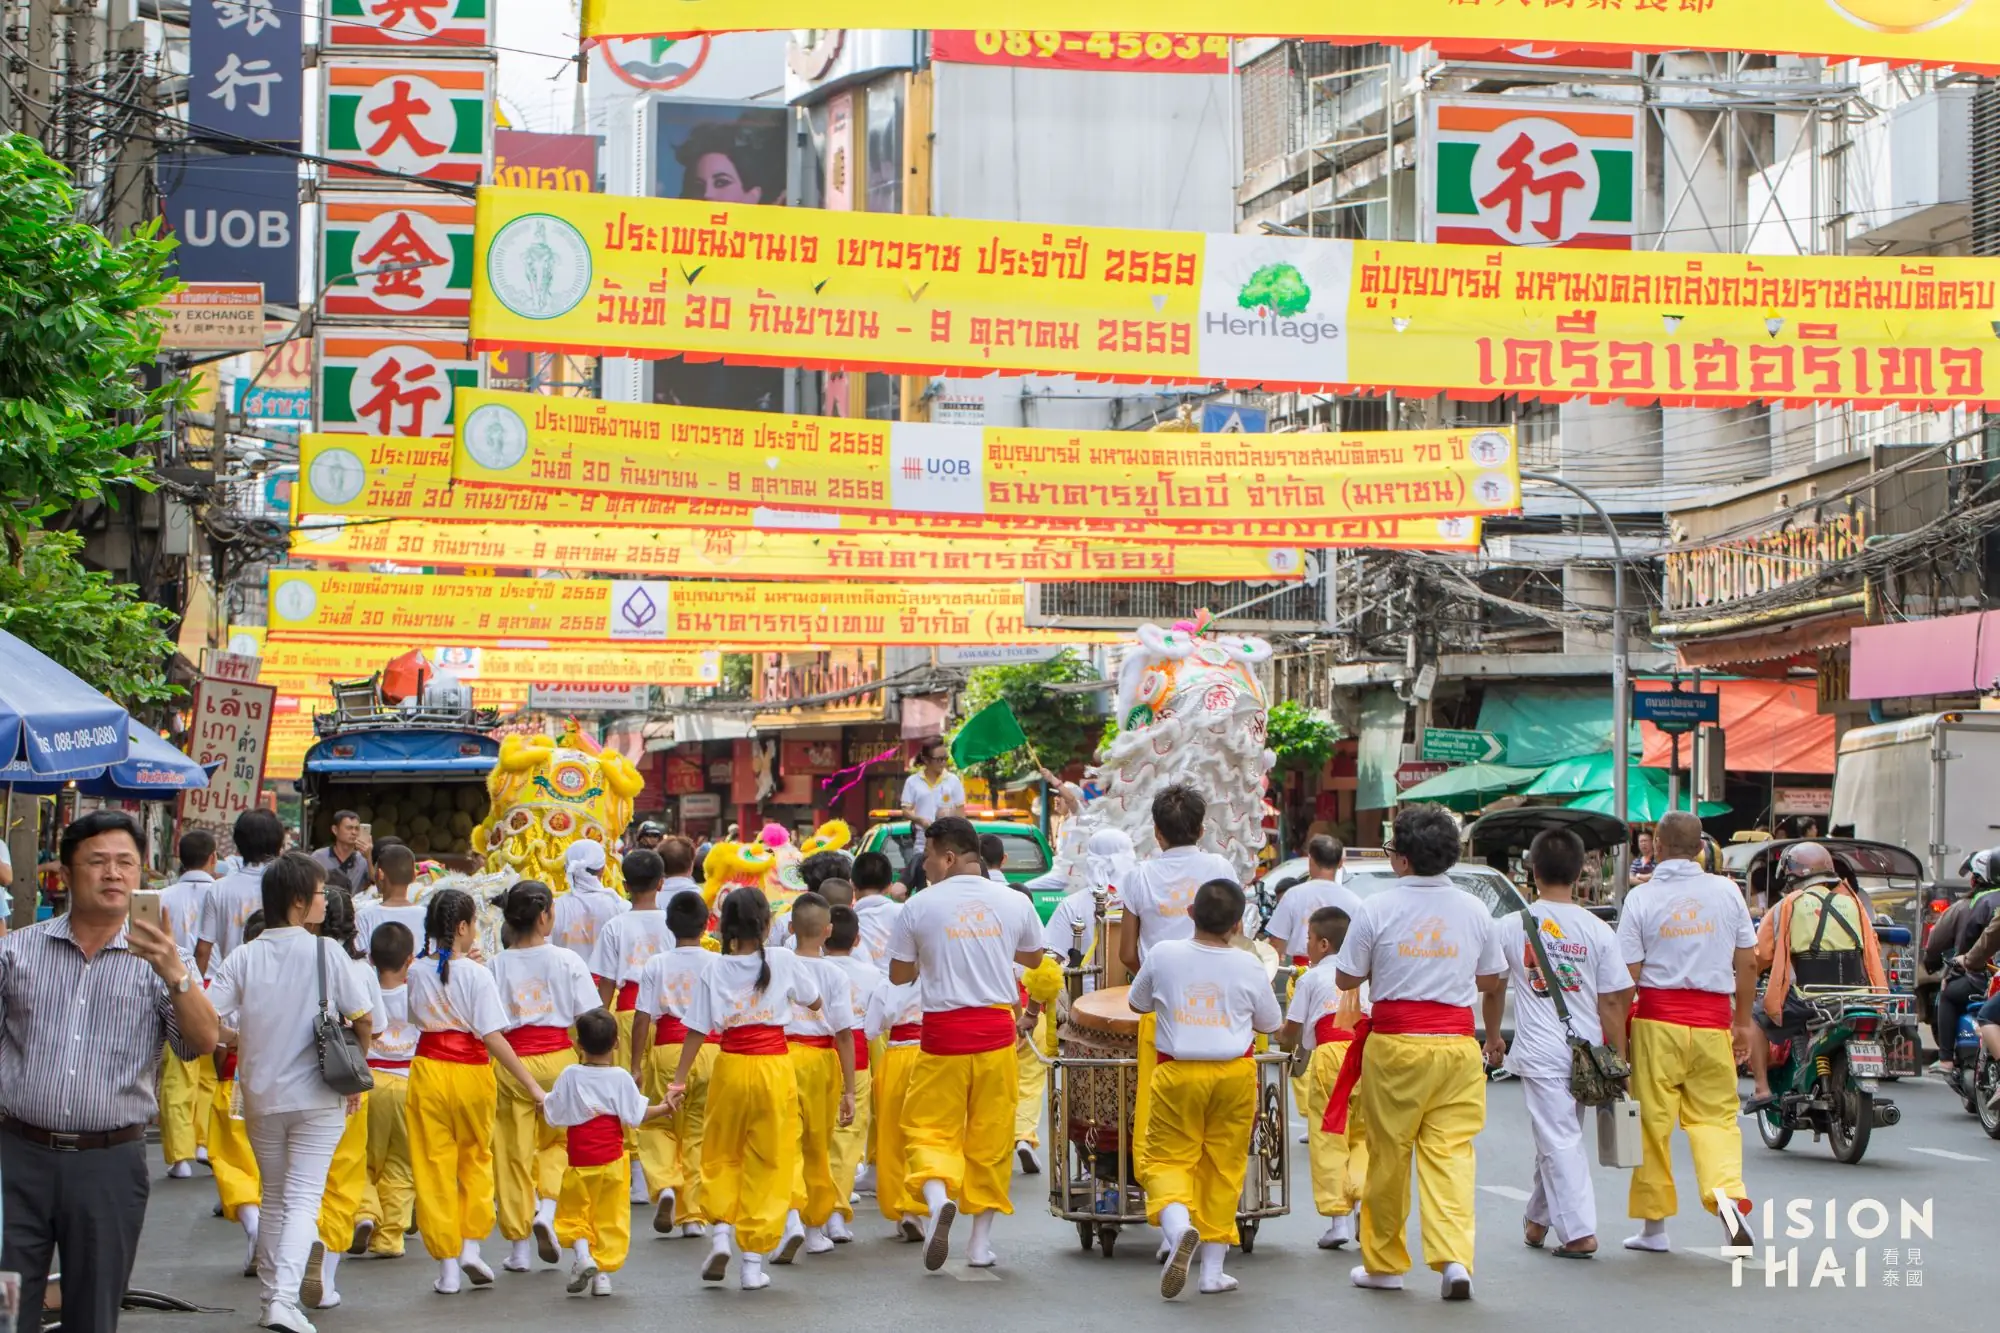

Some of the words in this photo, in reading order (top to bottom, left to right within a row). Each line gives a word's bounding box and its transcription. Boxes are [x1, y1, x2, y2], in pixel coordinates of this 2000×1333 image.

[1480, 131, 1586, 241] 行
[184, 209, 291, 249] UOB
[604, 211, 818, 264] ประเพณีงานเจ
[837, 235, 961, 272] เยาวราช
[977, 233, 1089, 280] ประจำปี
[1104, 248, 1197, 286] 2559
[1360, 250, 1503, 309] คู่บุญบารมี
[187, 310, 255, 321] EXCHANGE
[597, 267, 668, 327] วันที่
[684, 293, 731, 330] 30
[749, 287, 880, 340] กันยายน
[930, 309, 952, 342] 9
[969, 315, 1080, 358] ตุลาคม
[1097, 318, 1192, 356] 2559
[1205, 311, 1340, 345] Heritage
[1474, 308, 1985, 397] เครือเฮอริเทจ
[534, 405, 660, 440] ประเพณีงานเจ
[671, 422, 744, 448] เยาวราช
[754, 420, 819, 453] ประจำปี
[830, 431, 885, 456] 2559
[928, 458, 971, 476] UOB
[988, 436, 1081, 471] คู่บุญบารมี
[1413, 443, 1441, 462] 70
[1451, 435, 1464, 461] ปี
[531, 442, 573, 481] วันที่
[582, 460, 610, 483] 30
[620, 456, 699, 489] กันยายน
[727, 471, 741, 492] 9
[751, 475, 817, 502] ตุลาคม
[828, 478, 885, 500] 2559
[367, 474, 416, 508] วันที่
[423, 488, 454, 508] 30
[464, 488, 548, 512] กนยายน
[988, 470, 1230, 517] ธนาคารยูโอบี
[1246, 472, 1325, 507] จำกัด
[1341, 471, 1466, 512] (มหาชน)
[397, 534, 425, 554] 30
[433, 531, 505, 557] กันยายน
[531, 542, 543, 560] 9
[554, 544, 618, 567] ตุลาคม
[627, 545, 681, 565] 2559
[320, 577, 425, 597] ประเพณีงานเจ
[432, 583, 493, 599] เยาวราช
[499, 579, 555, 601] ประจำปี
[561, 585, 608, 601] 2559
[317, 601, 354, 626] วันที่
[360, 609, 385, 626] 30
[391, 606, 456, 628] กันยายน
[478, 613, 492, 629] 9
[497, 615, 552, 635] ตุลาคม
[558, 614, 606, 632] 2559
[676, 612, 885, 643] ธนาคารกรุงเทพ
[900, 607, 970, 635] จำกัด
[1006, 647, 1039, 657] TOURS
[206, 688, 262, 721] เล้ง
[54, 725, 118, 752] 088-088-0880
[202, 720, 237, 742] เกา
[238, 725, 256, 754] คั่ว
[234, 758, 255, 780] มือ
